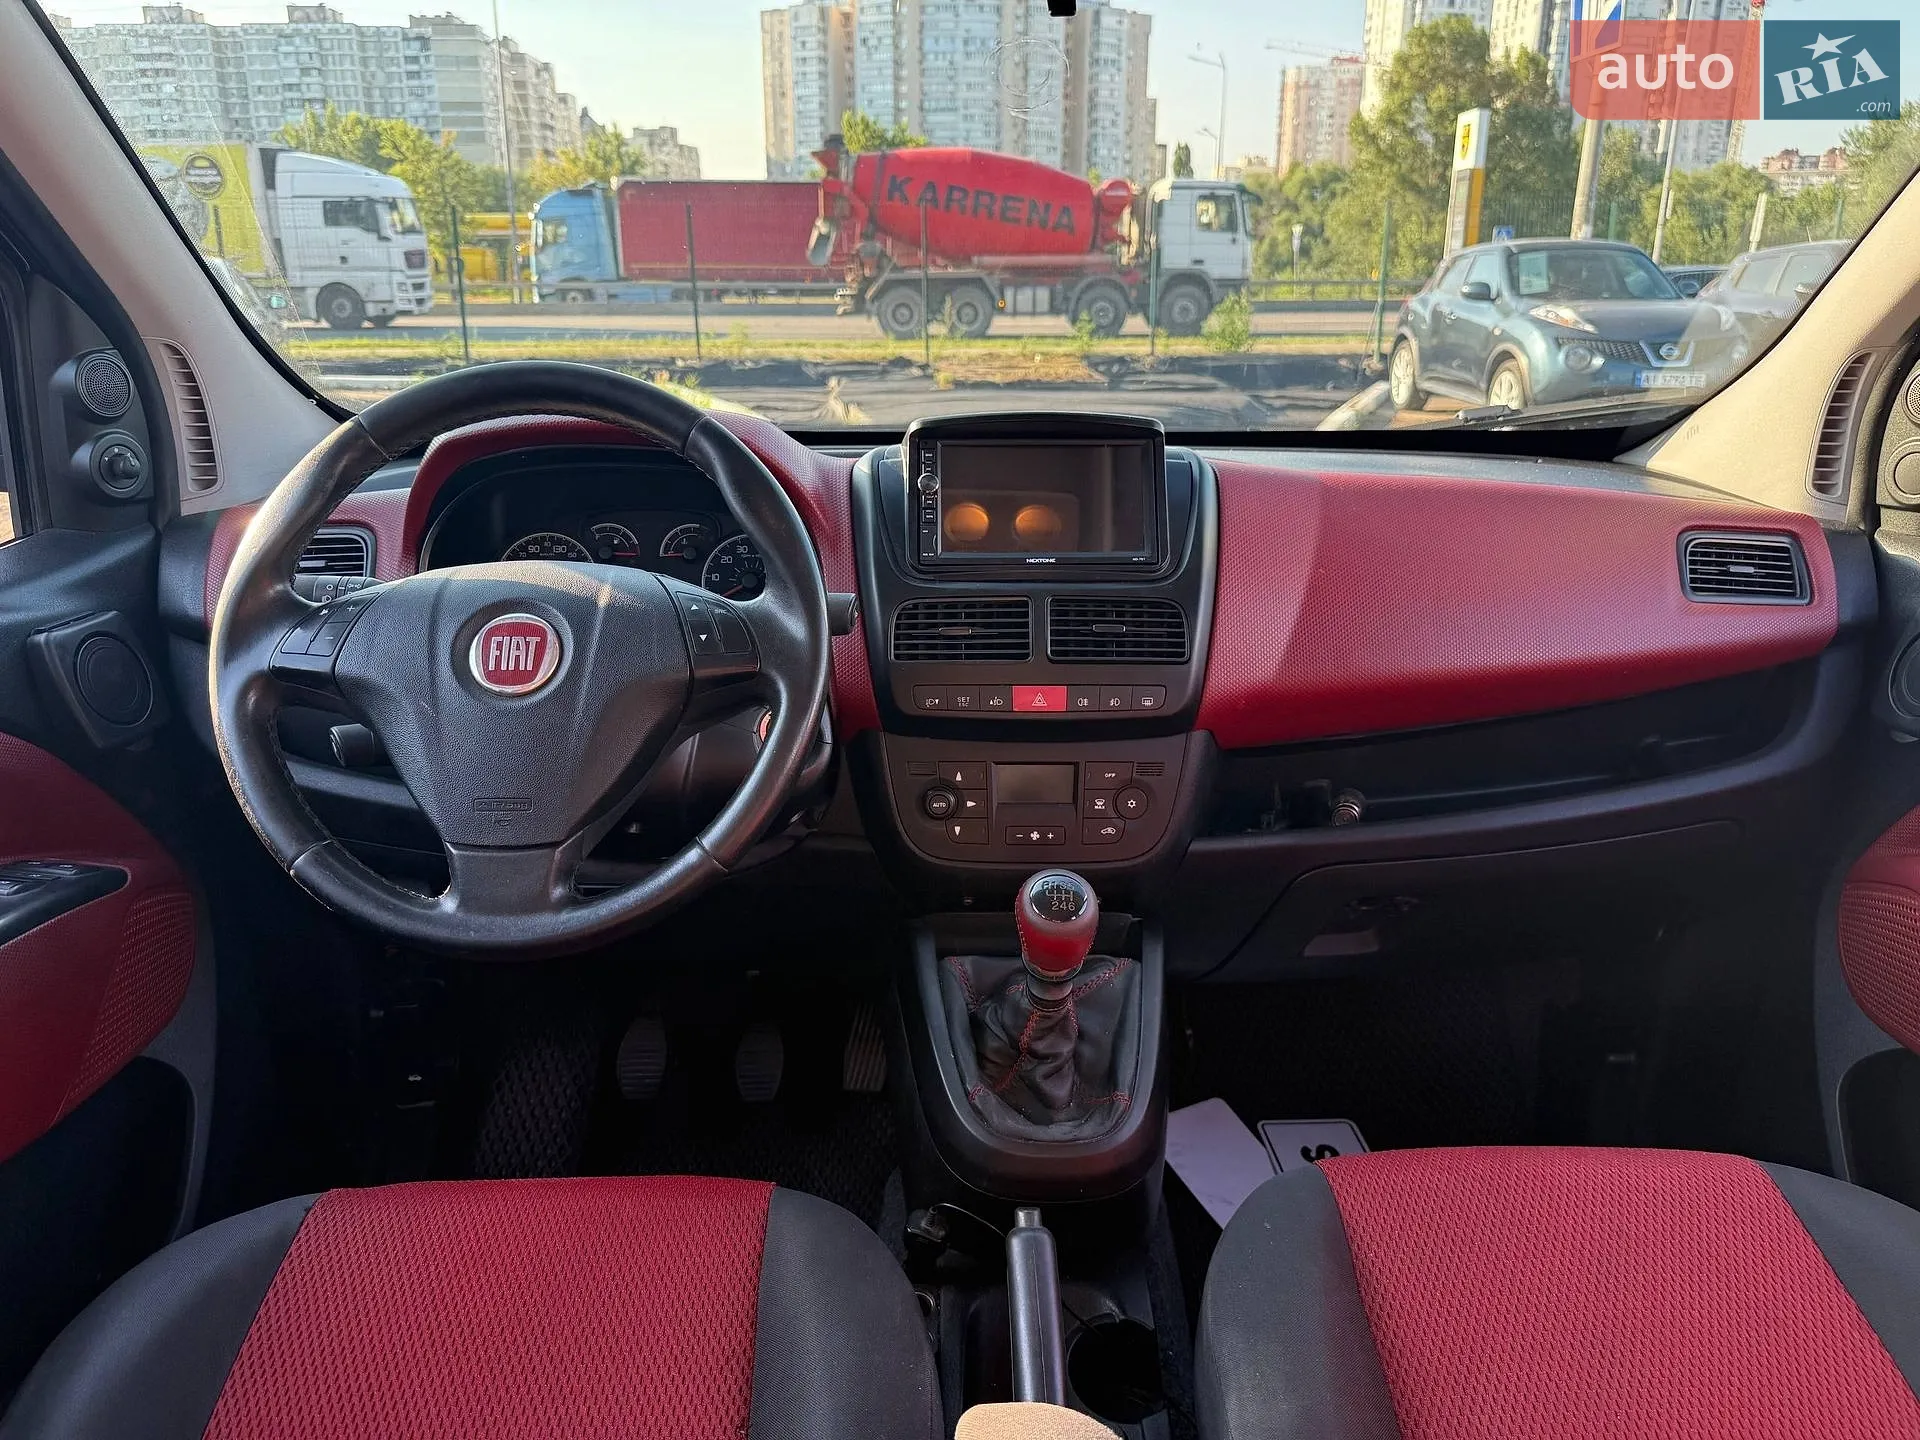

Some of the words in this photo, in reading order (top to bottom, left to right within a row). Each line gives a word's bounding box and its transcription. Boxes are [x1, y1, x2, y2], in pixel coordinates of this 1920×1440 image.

[886, 173, 1075, 236] KARRENA
[528, 545, 540, 553] 90
[553, 545, 567, 553] 130
[736, 545, 749, 553] 30
[720, 555, 733, 564] 20
[711, 573, 720, 581] 10
[488, 636, 541, 671] FIAT
